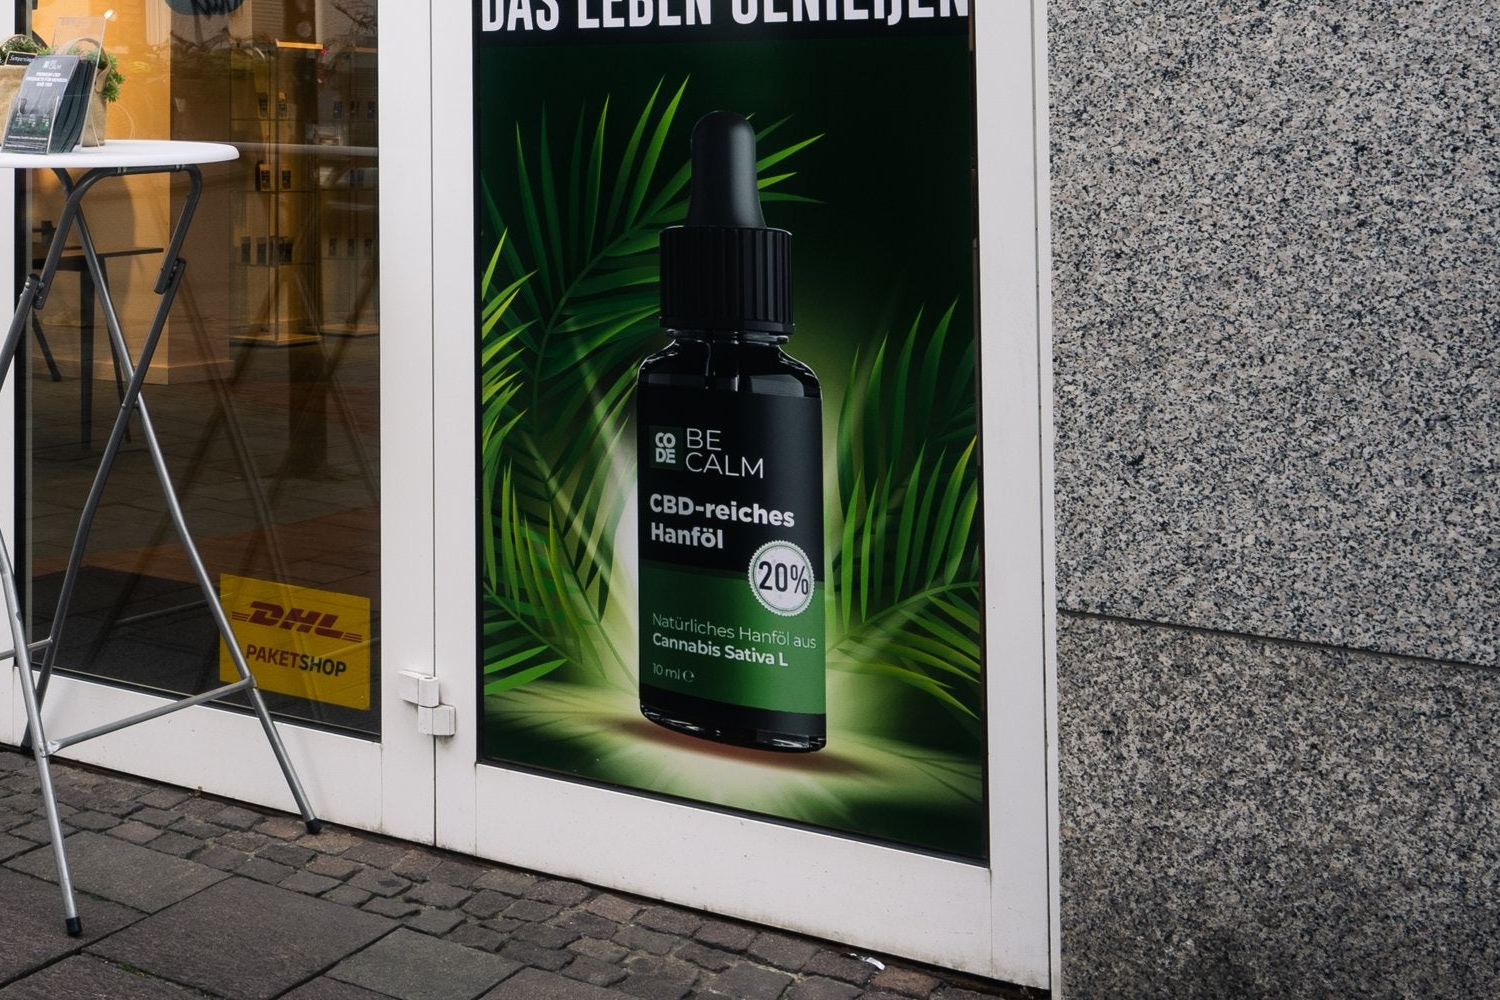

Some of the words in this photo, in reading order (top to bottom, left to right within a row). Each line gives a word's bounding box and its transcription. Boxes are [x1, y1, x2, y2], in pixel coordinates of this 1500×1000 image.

[686, 428, 722, 451] BE
[685, 452, 764, 479] CALM
[650, 493, 795, 528] CBD-reiches
[651, 522, 724, 549] Hanföl
[758, 561, 809, 595] 20%
[248, 601, 344, 639] DHL
[653, 613, 735, 639] Natürliches
[739, 626, 790, 646] Hanföl
[793, 636, 817, 649] aus
[246, 643, 347, 677] PAKETSHOP
[653, 633, 721, 657] Cannabis
[725, 645, 775, 665] Sativa
[779, 652, 789, 667] L
[653, 663, 663, 676] 10
[666, 667, 680, 680] ml
